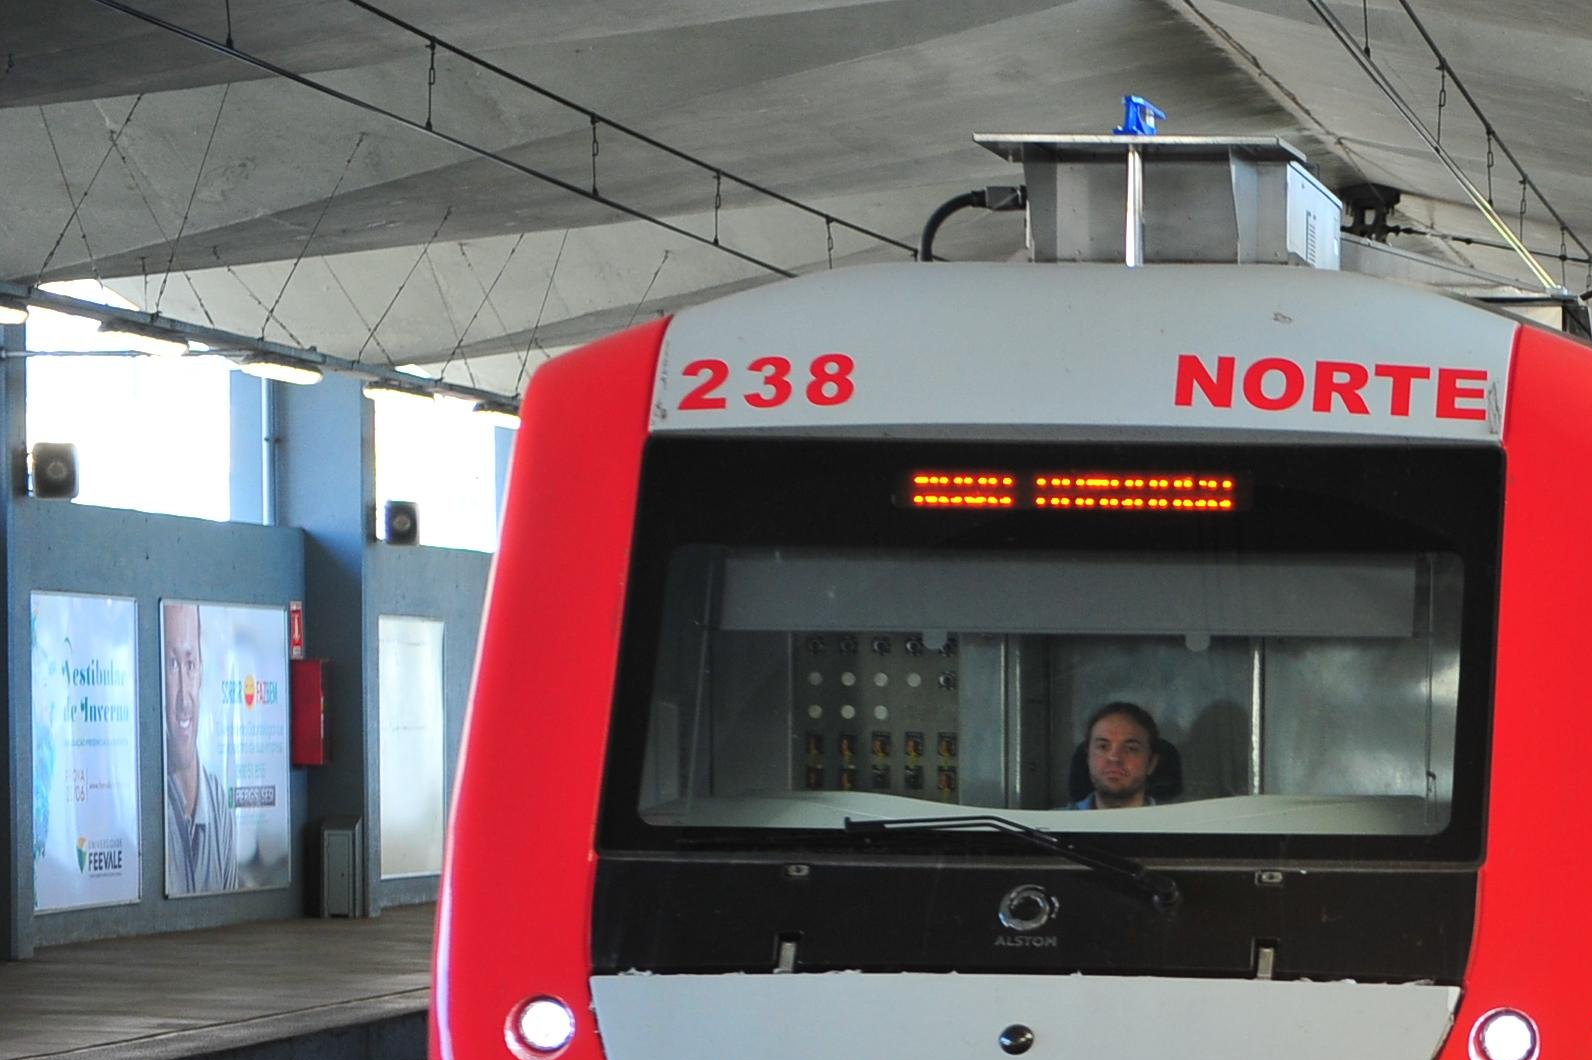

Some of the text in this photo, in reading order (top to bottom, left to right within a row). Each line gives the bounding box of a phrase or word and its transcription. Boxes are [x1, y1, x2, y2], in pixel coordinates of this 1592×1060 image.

[678, 353, 855, 411] 238
[1174, 354, 1488, 421] NORTE
[88, 850, 122, 872] FEEVALE
[994, 935, 1057, 947] ALSTOM
